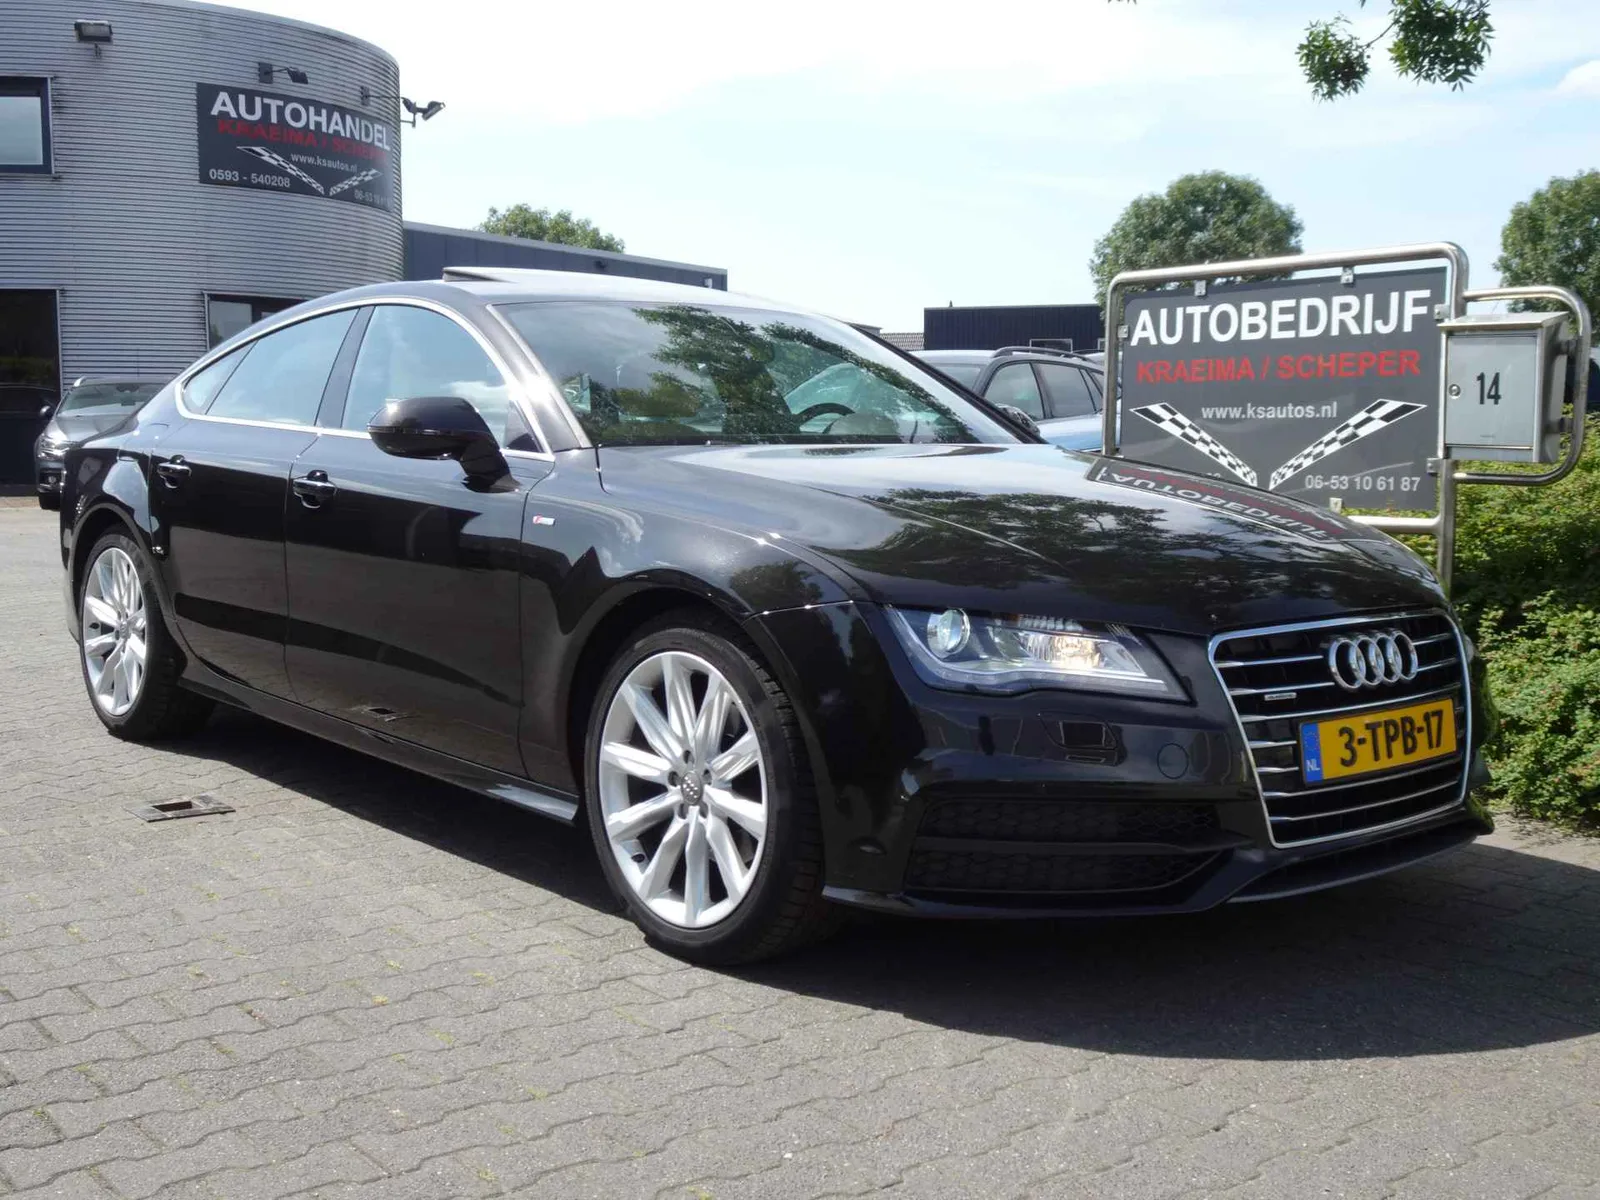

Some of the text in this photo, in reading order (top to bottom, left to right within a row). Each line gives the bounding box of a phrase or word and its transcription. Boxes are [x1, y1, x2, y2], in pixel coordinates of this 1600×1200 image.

[210, 91, 390, 151] AUTOHANDEL
[217, 119, 318, 148] KRAEIMA
[290, 152, 357, 173] www.ksautos.nl
[209, 168, 239, 182] 0593
[251, 173, 290, 188] 540208
[1130, 289, 1431, 346] AUTOBEDRIJF
[1136, 356, 1255, 384] KRAEIMA
[1277, 350, 1421, 379] SCHEPER
[1476, 372, 1501, 405] 14
[1201, 401, 1338, 419] www.ksautos.nl
[1305, 475, 1421, 492] 06-53 10 61 87
[1338, 709, 1444, 768] 3-TPB-17
[1306, 758, 1321, 772] NL
